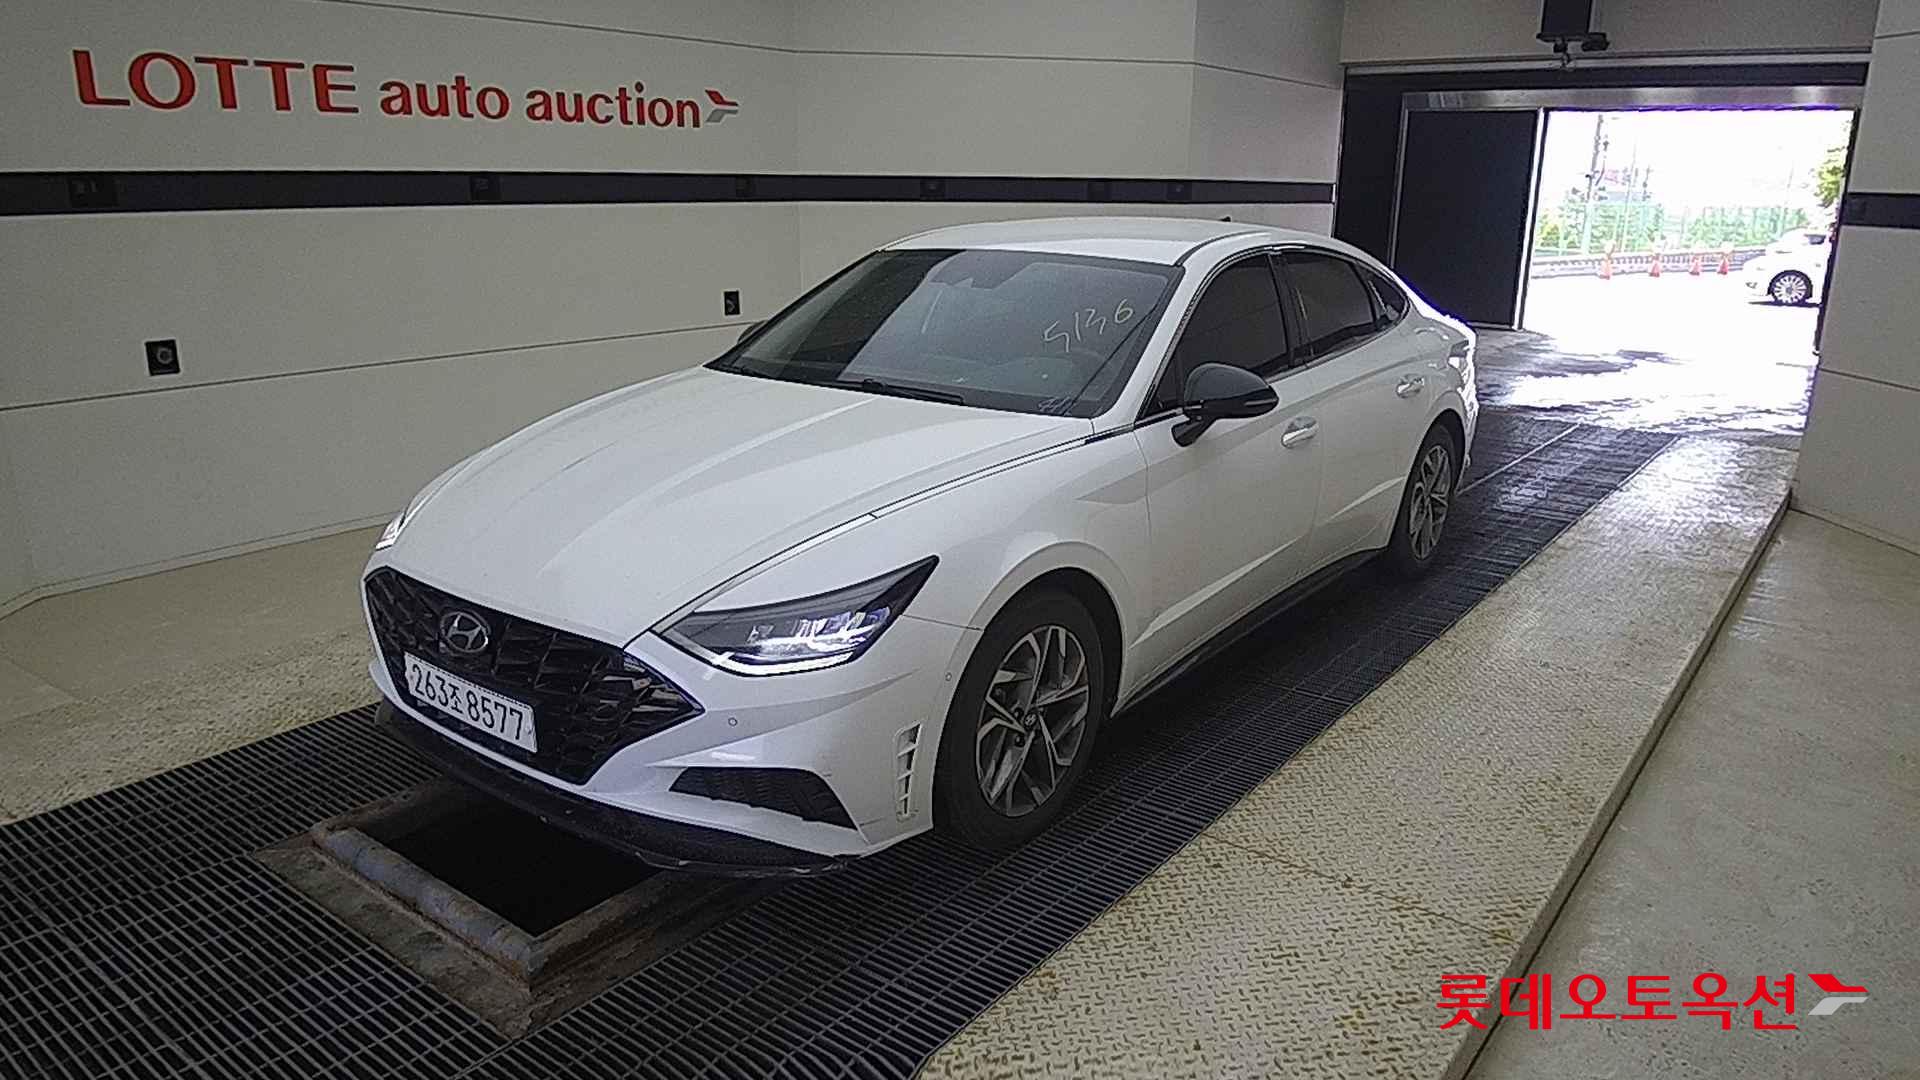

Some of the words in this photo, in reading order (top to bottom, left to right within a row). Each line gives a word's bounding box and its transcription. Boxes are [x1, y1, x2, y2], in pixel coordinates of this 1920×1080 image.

[72, 49, 359, 114] LOTTE
[379, 75, 510, 120] auto
[525, 82, 701, 128] auction
